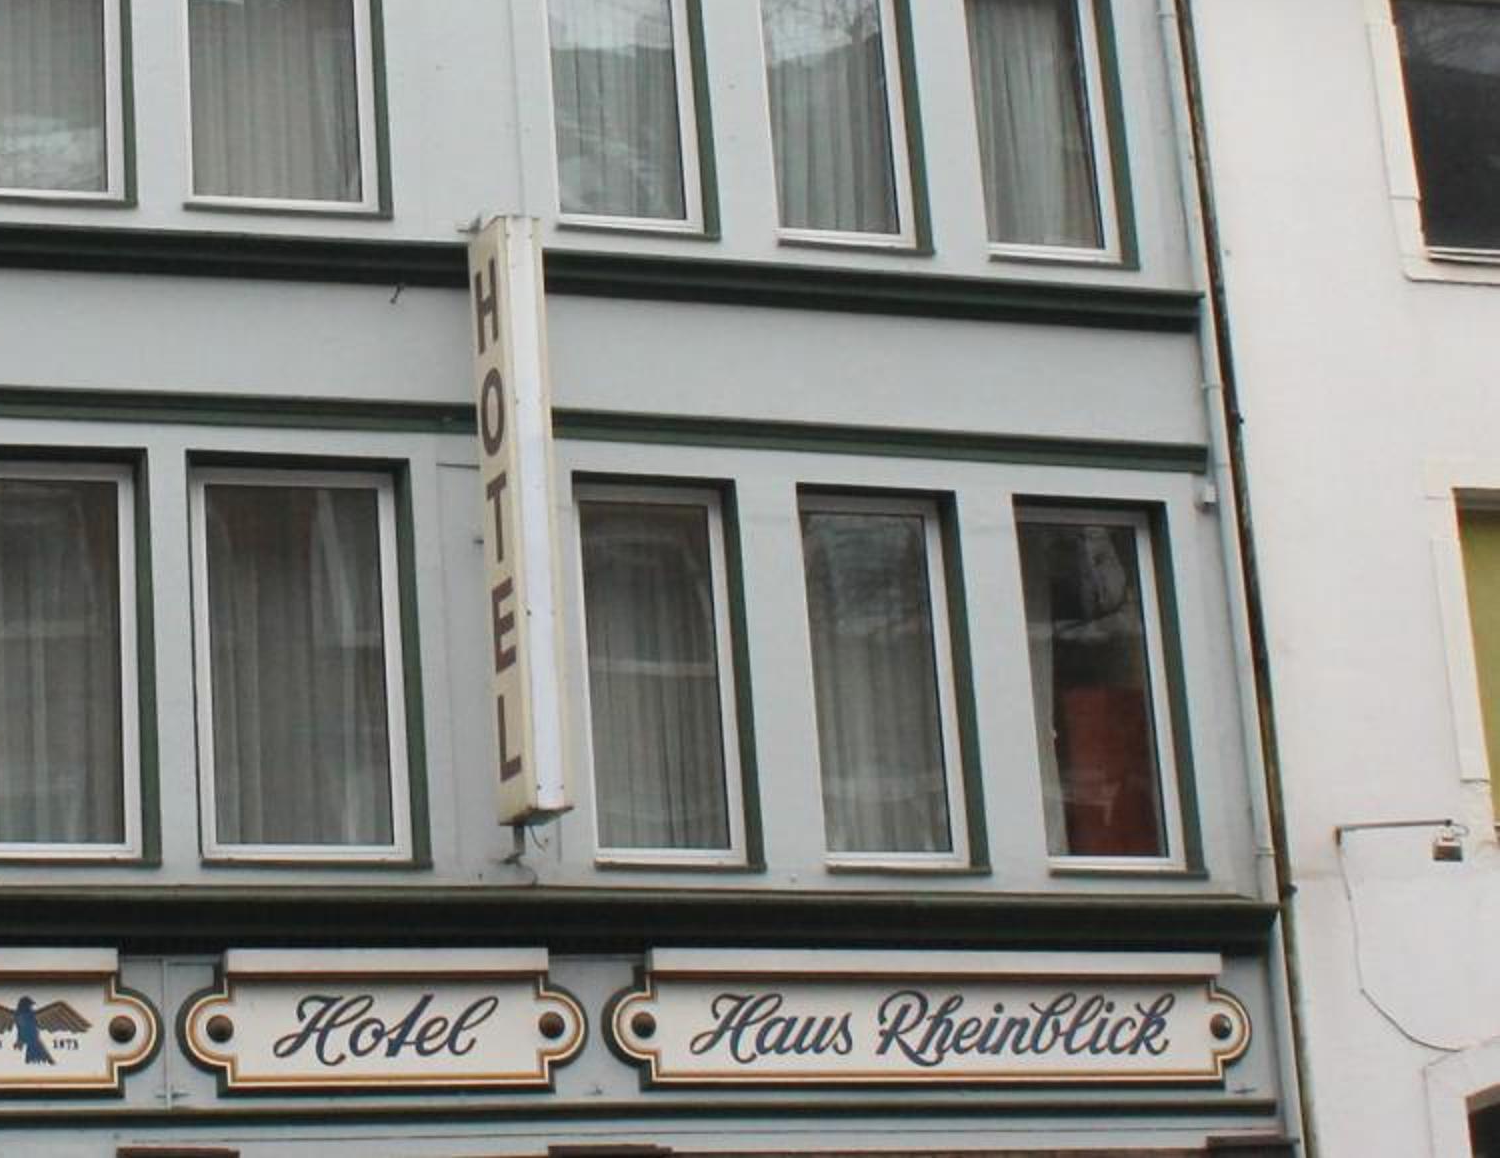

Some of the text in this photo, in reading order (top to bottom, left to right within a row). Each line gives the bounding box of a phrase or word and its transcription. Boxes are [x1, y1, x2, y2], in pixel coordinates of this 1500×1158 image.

[472, 258, 522, 784] HOTEL
[273, 994, 499, 1067] Hotel
[689, 990, 1177, 1068] Haus Rheinblick
